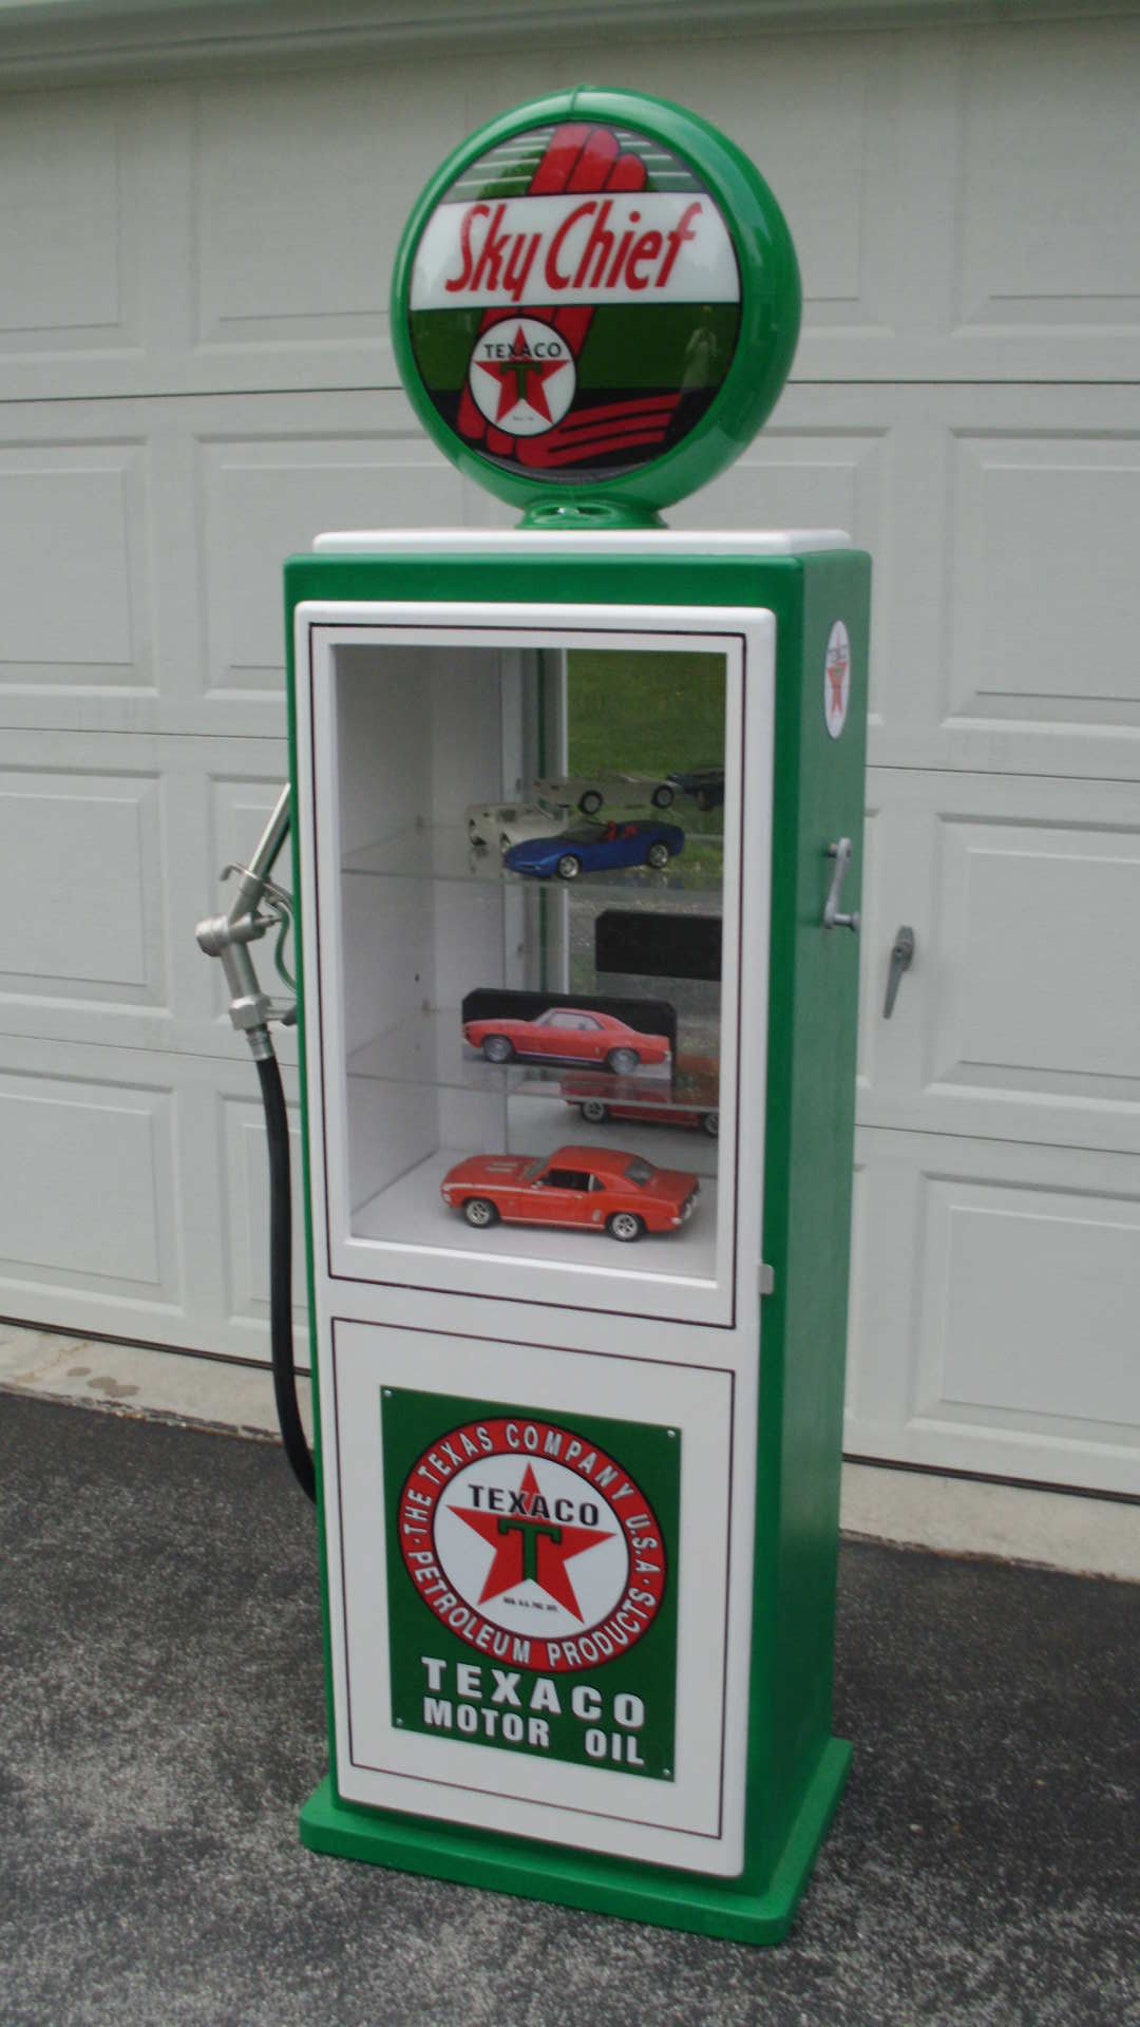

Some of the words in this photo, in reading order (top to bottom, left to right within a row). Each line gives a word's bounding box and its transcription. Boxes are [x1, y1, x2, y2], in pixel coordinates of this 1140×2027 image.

[445, 203, 542, 302] Sky
[545, 200, 704, 290] Chief
[484, 342, 562, 358] TEXACO
[404, 1489, 431, 1534] THE
[418, 1427, 493, 1484] TEXAS
[505, 1423, 634, 1501] COMPANY
[468, 1484, 599, 1526] TEXACO
[408, 1550, 530, 1663] PETROLEUM
[547, 1587, 656, 1667] PRODUCTS
[421, 1656, 645, 1728] TEXACO
[423, 1697, 550, 1748] MOTOR
[585, 1729, 645, 1765] OIL
